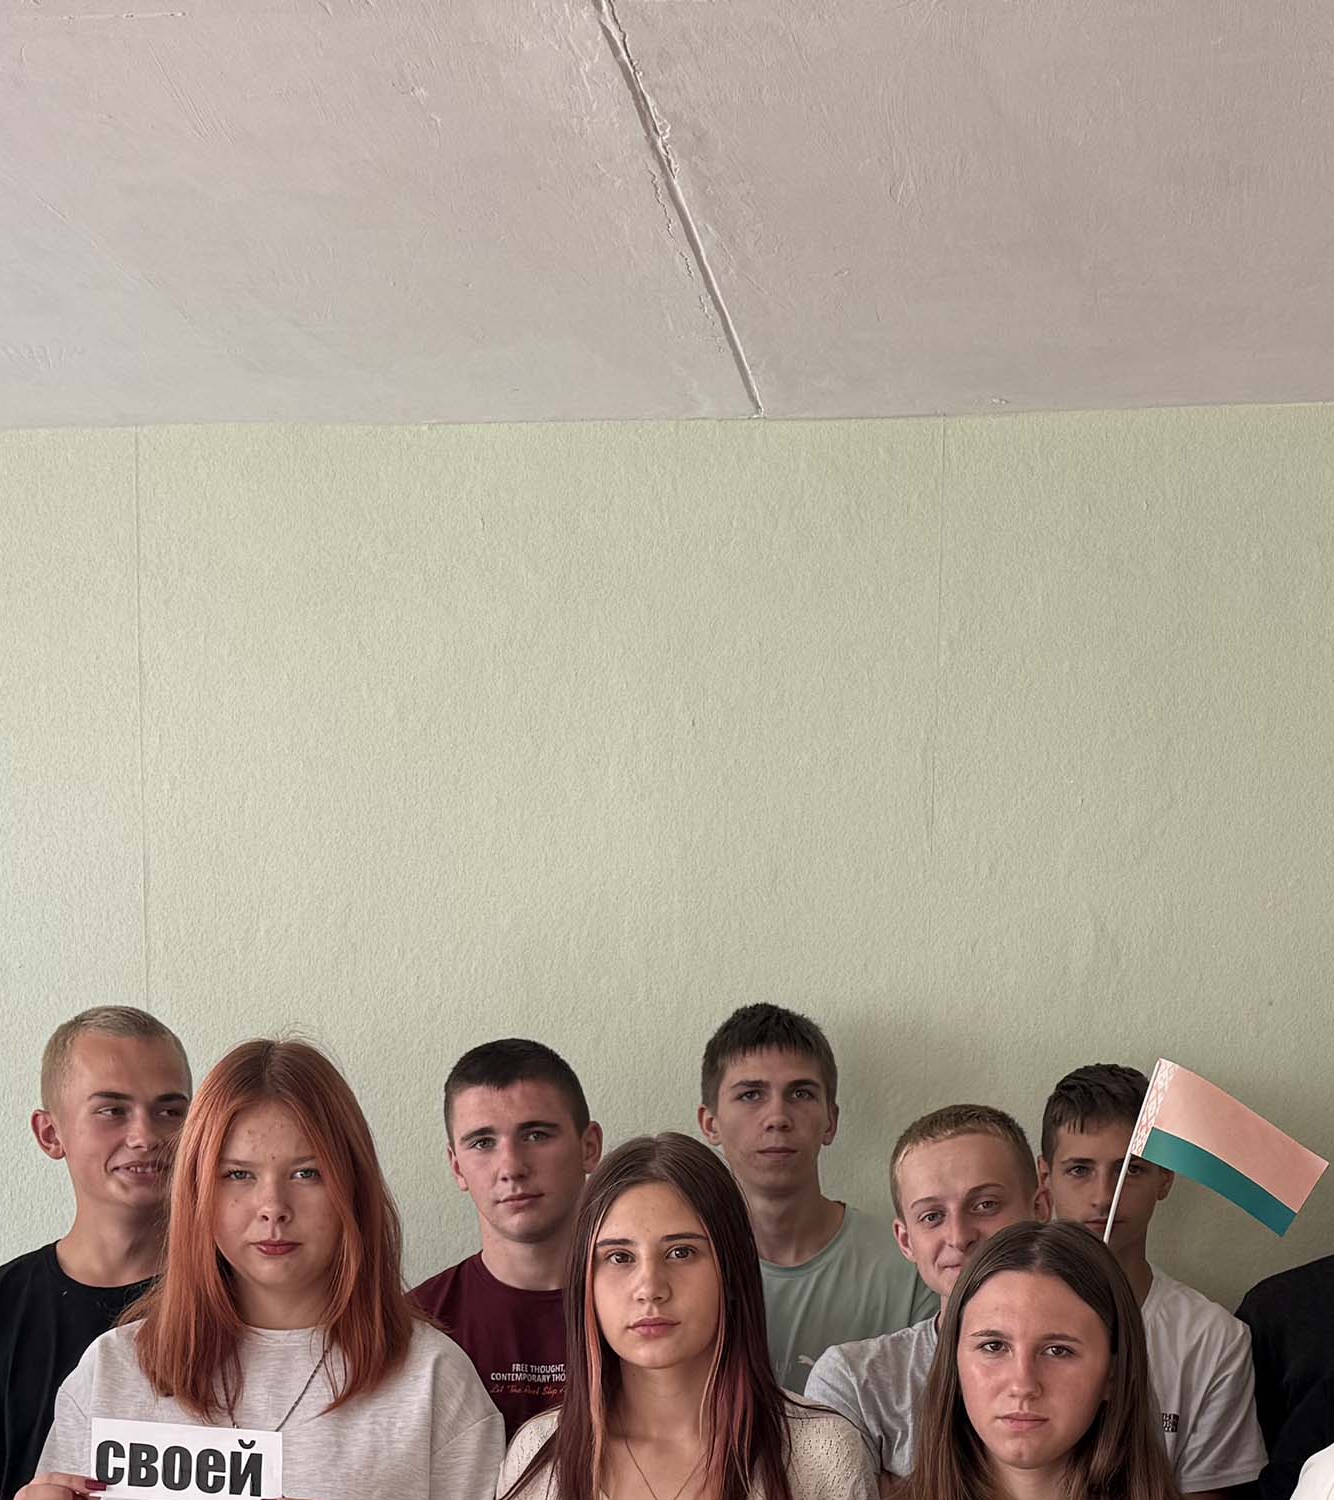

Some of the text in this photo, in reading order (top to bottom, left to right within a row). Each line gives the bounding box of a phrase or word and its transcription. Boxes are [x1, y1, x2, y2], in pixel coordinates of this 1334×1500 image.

[512, 1364, 528, 1372] FREE
[490, 1373, 566, 1382] CONTEMPORARY THO
[96, 1438, 263, 1497] своей
